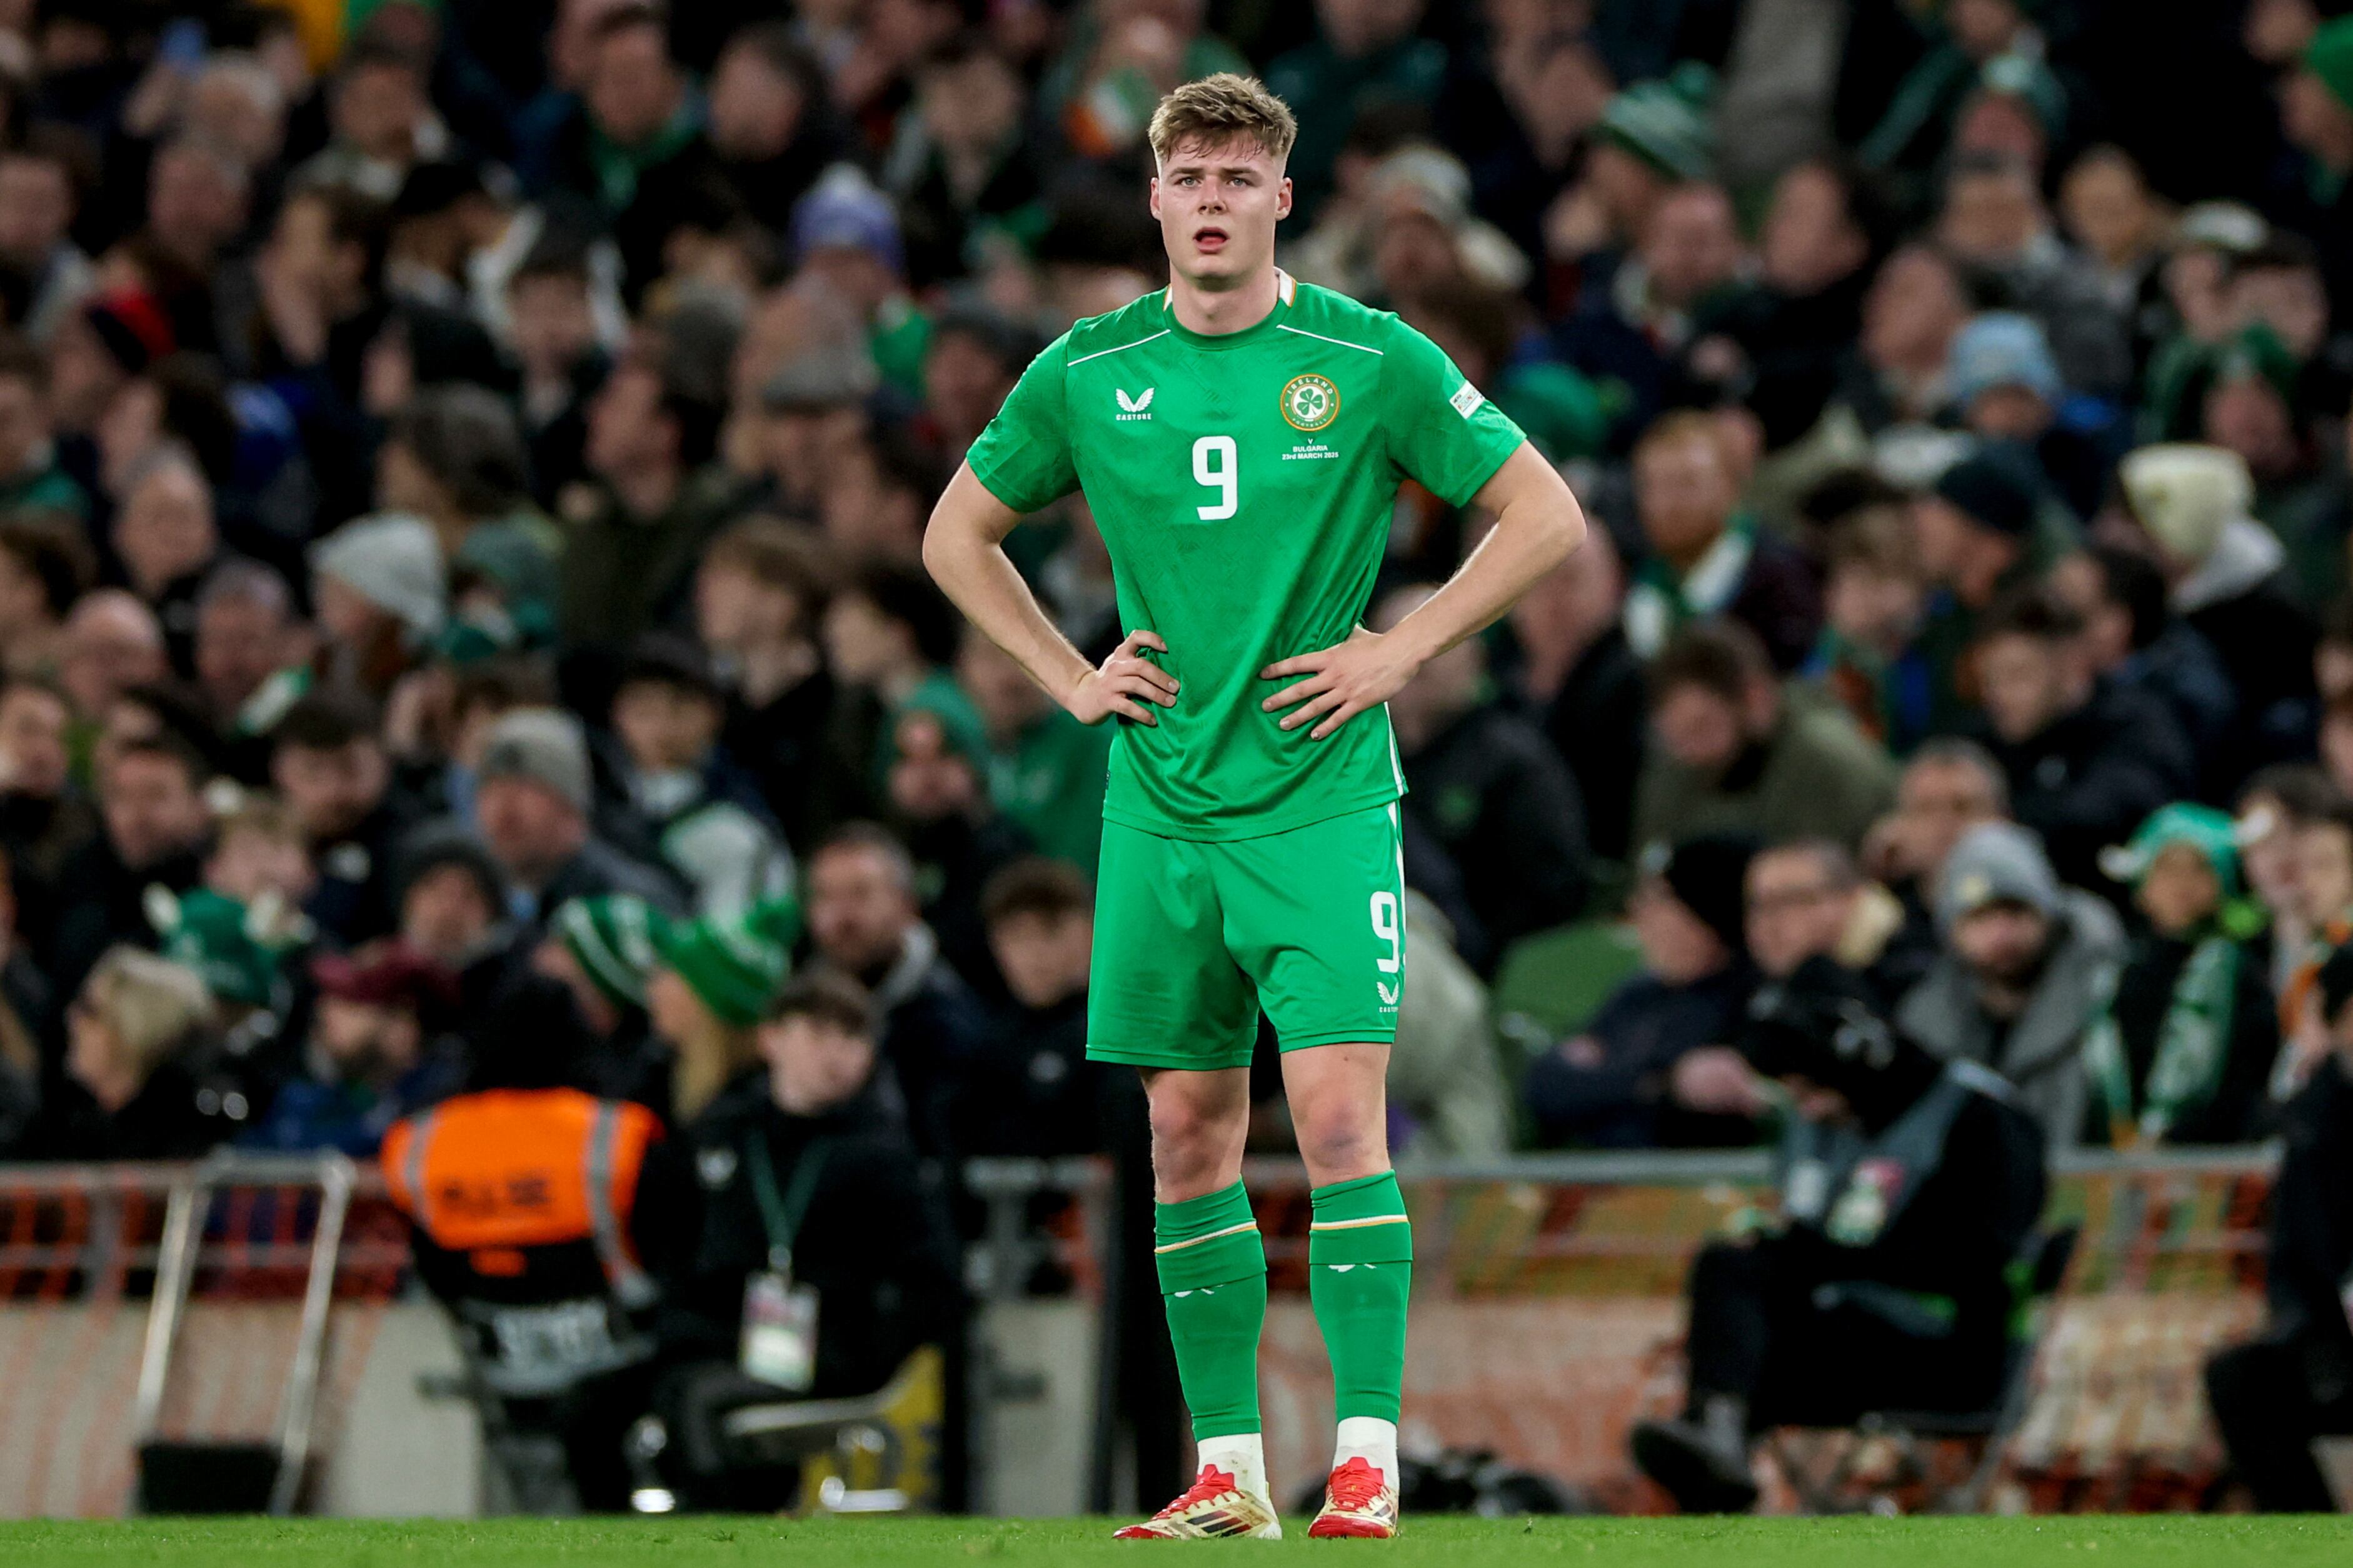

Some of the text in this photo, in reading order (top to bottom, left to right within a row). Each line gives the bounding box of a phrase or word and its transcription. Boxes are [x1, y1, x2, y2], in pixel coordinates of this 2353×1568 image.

[1287, 377, 1333, 394] IRELAND
[1192, 435, 1238, 521] 9
[1370, 891, 1400, 974] 9
